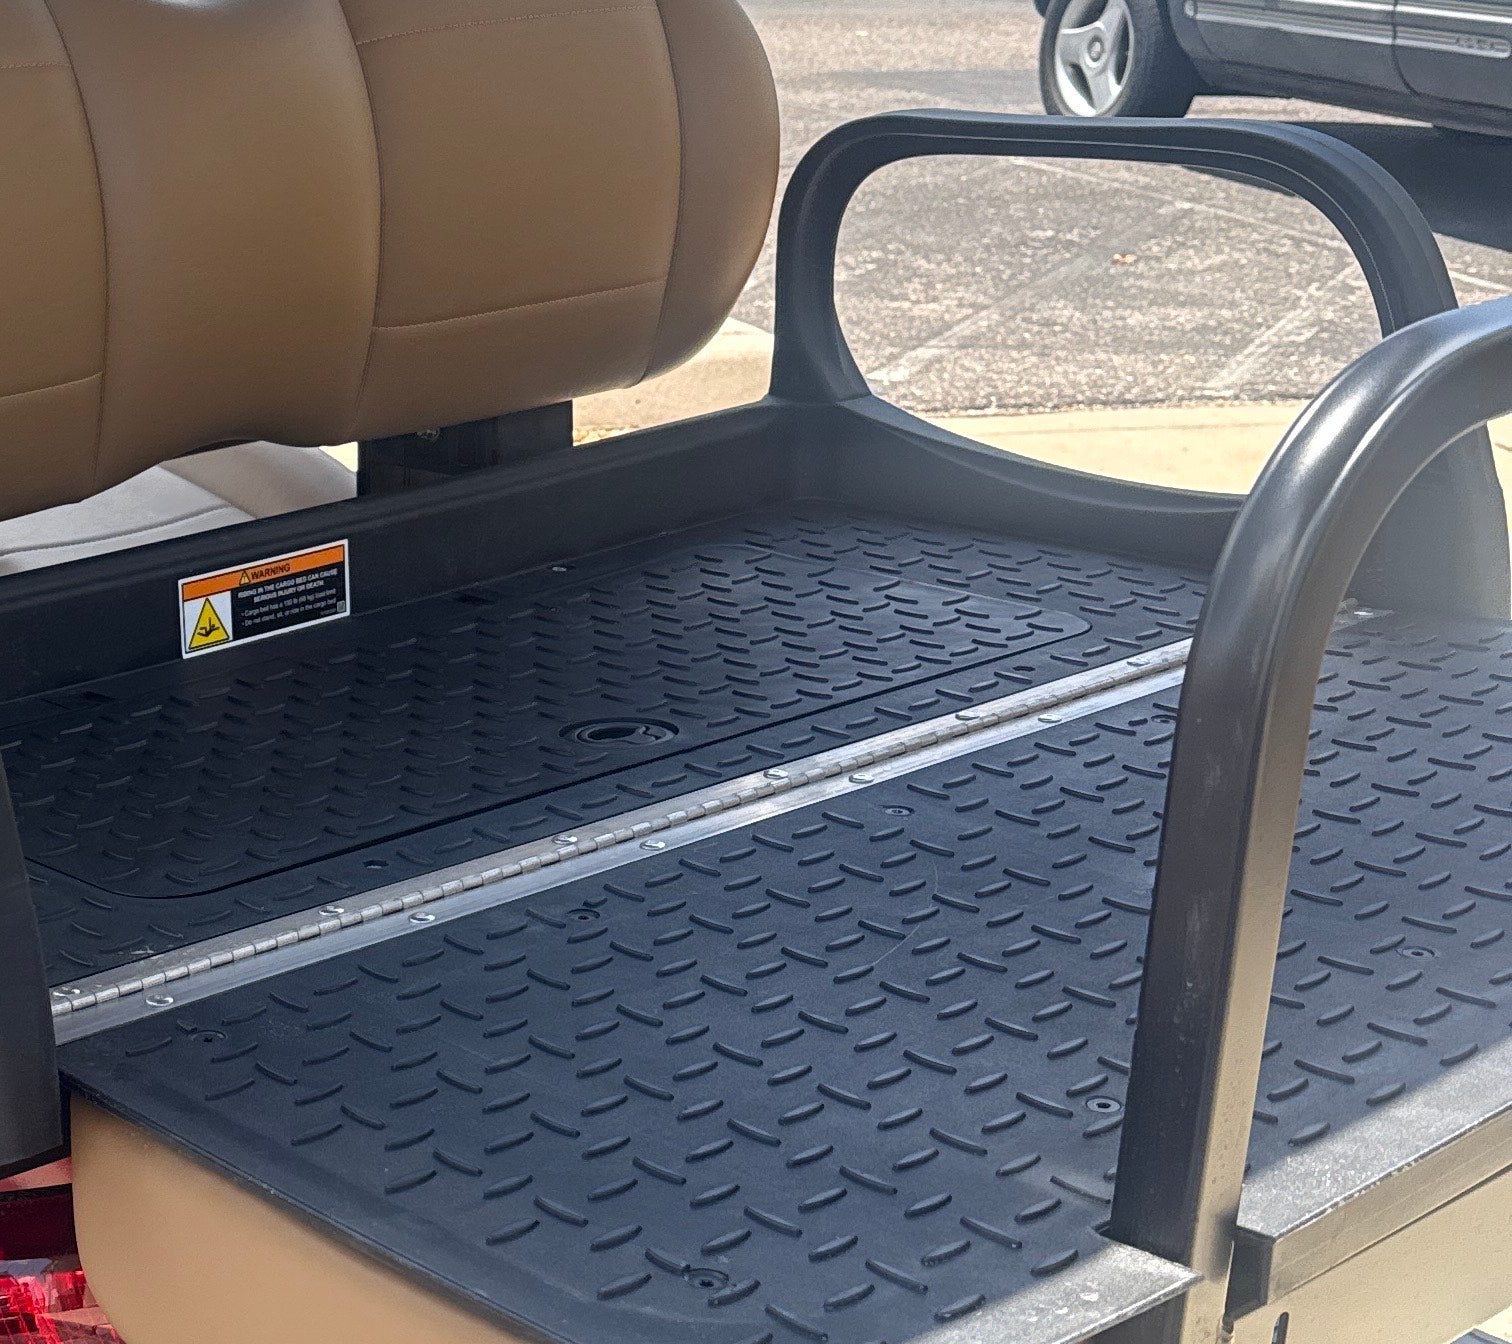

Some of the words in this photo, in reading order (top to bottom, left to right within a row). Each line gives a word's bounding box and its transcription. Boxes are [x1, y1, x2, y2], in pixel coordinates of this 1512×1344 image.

[251, 563, 291, 580] WARNING
[275, 578, 295, 589] CARGO
[308, 573, 319, 581] CAN
